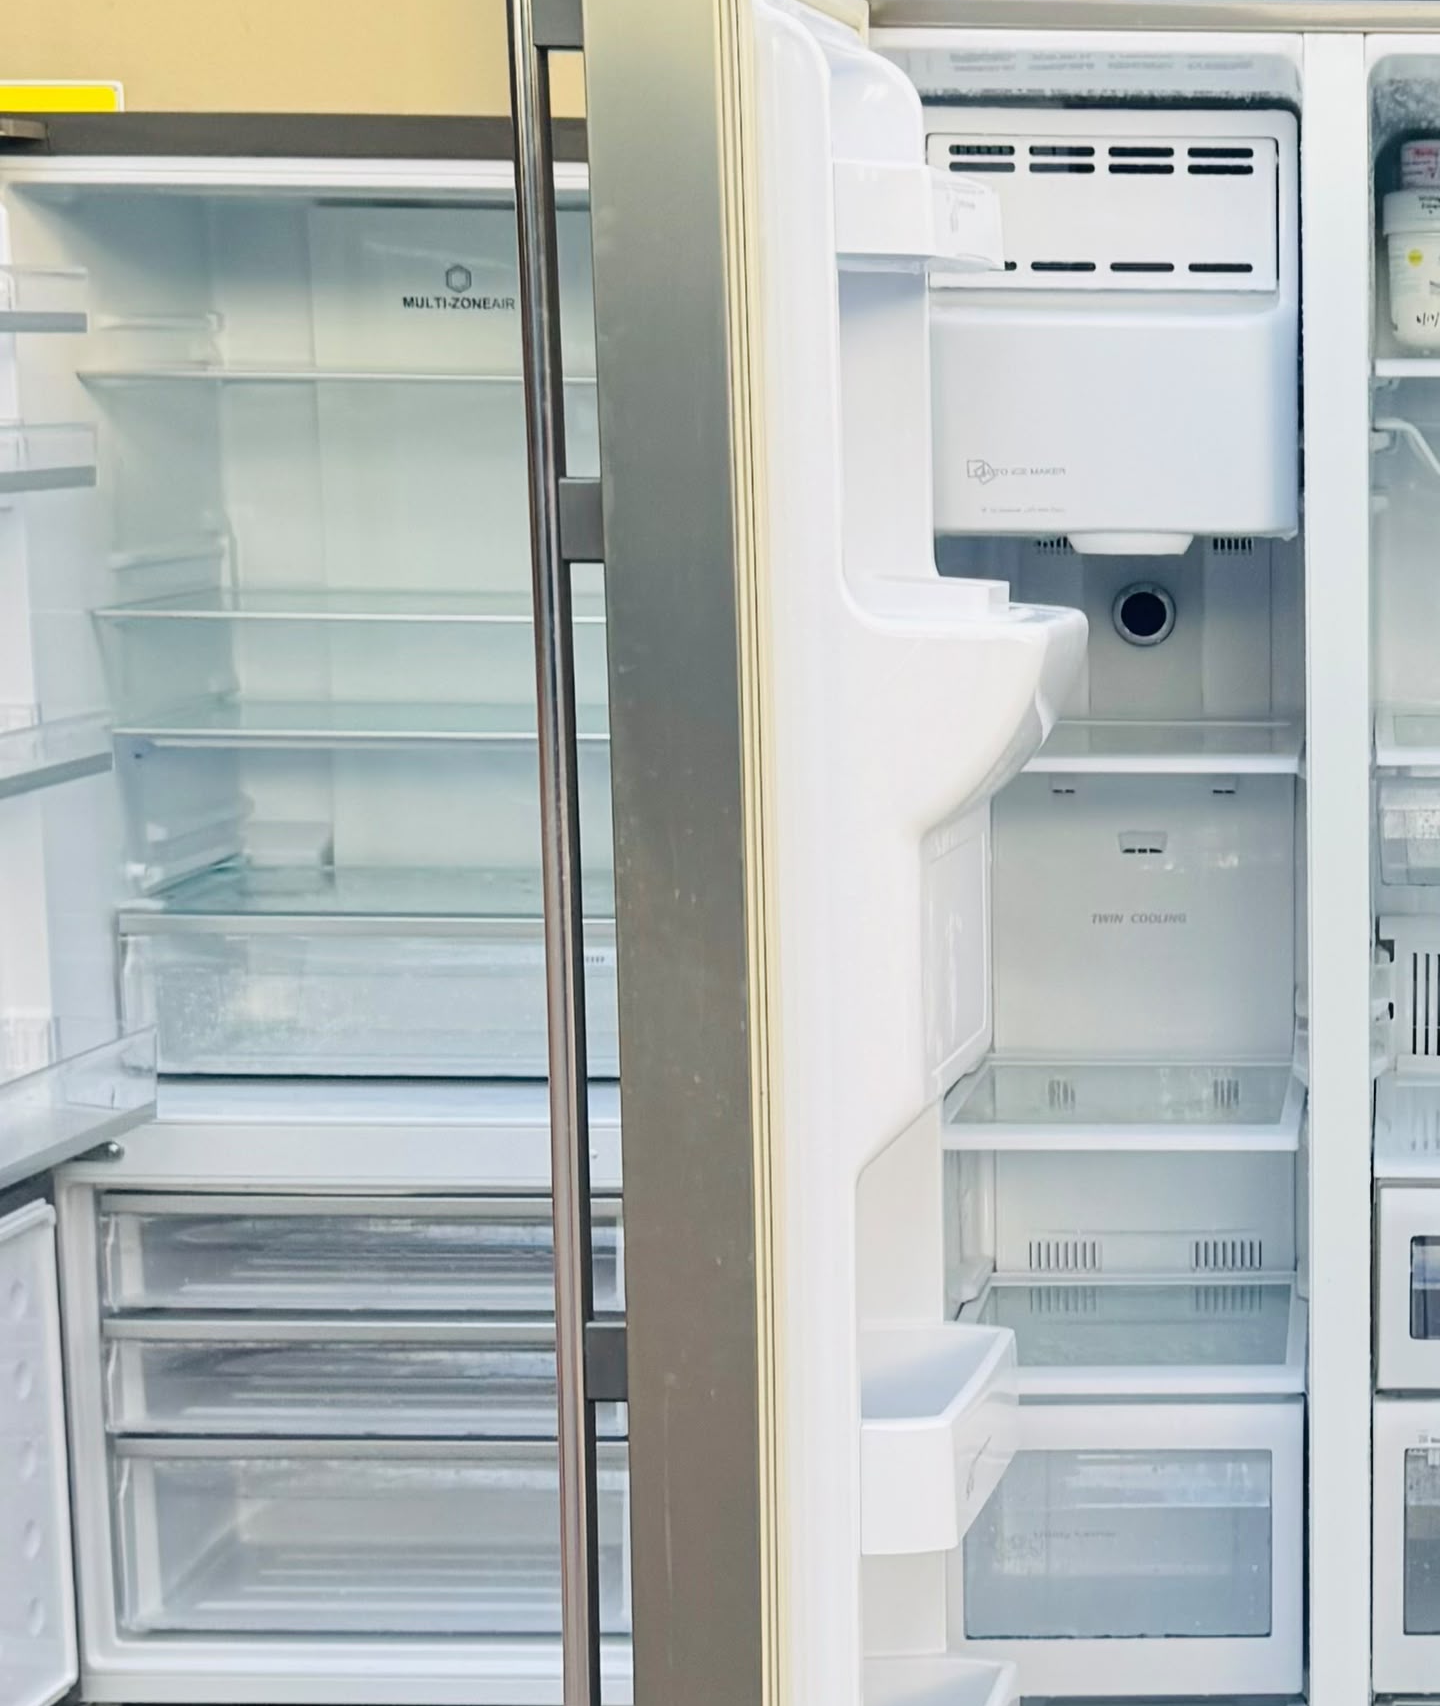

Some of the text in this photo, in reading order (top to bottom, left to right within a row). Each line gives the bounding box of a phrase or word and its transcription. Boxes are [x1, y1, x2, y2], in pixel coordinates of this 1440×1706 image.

[1030, 467, 1066, 476] MAKER
[1092, 912, 1187, 924] TWIN COOLING
